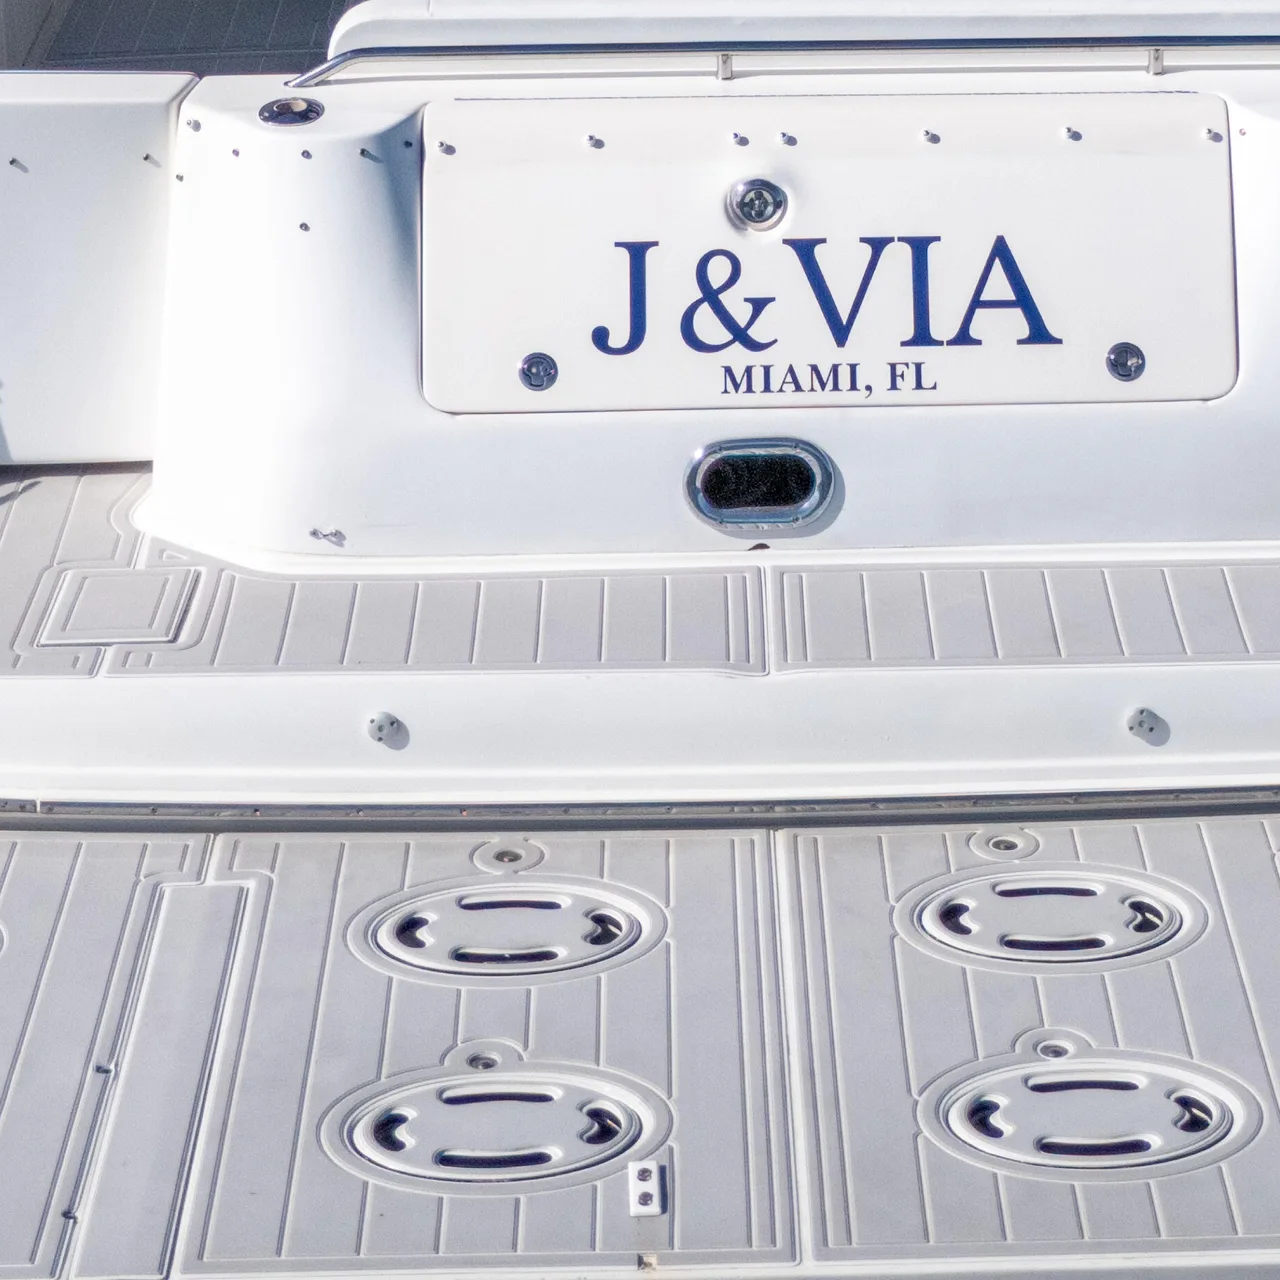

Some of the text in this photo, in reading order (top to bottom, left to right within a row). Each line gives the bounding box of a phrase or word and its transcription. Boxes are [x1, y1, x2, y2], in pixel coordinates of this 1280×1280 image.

[591, 235, 1063, 356] J&VIA
[721, 361, 938, 399] MIAMI, FL
